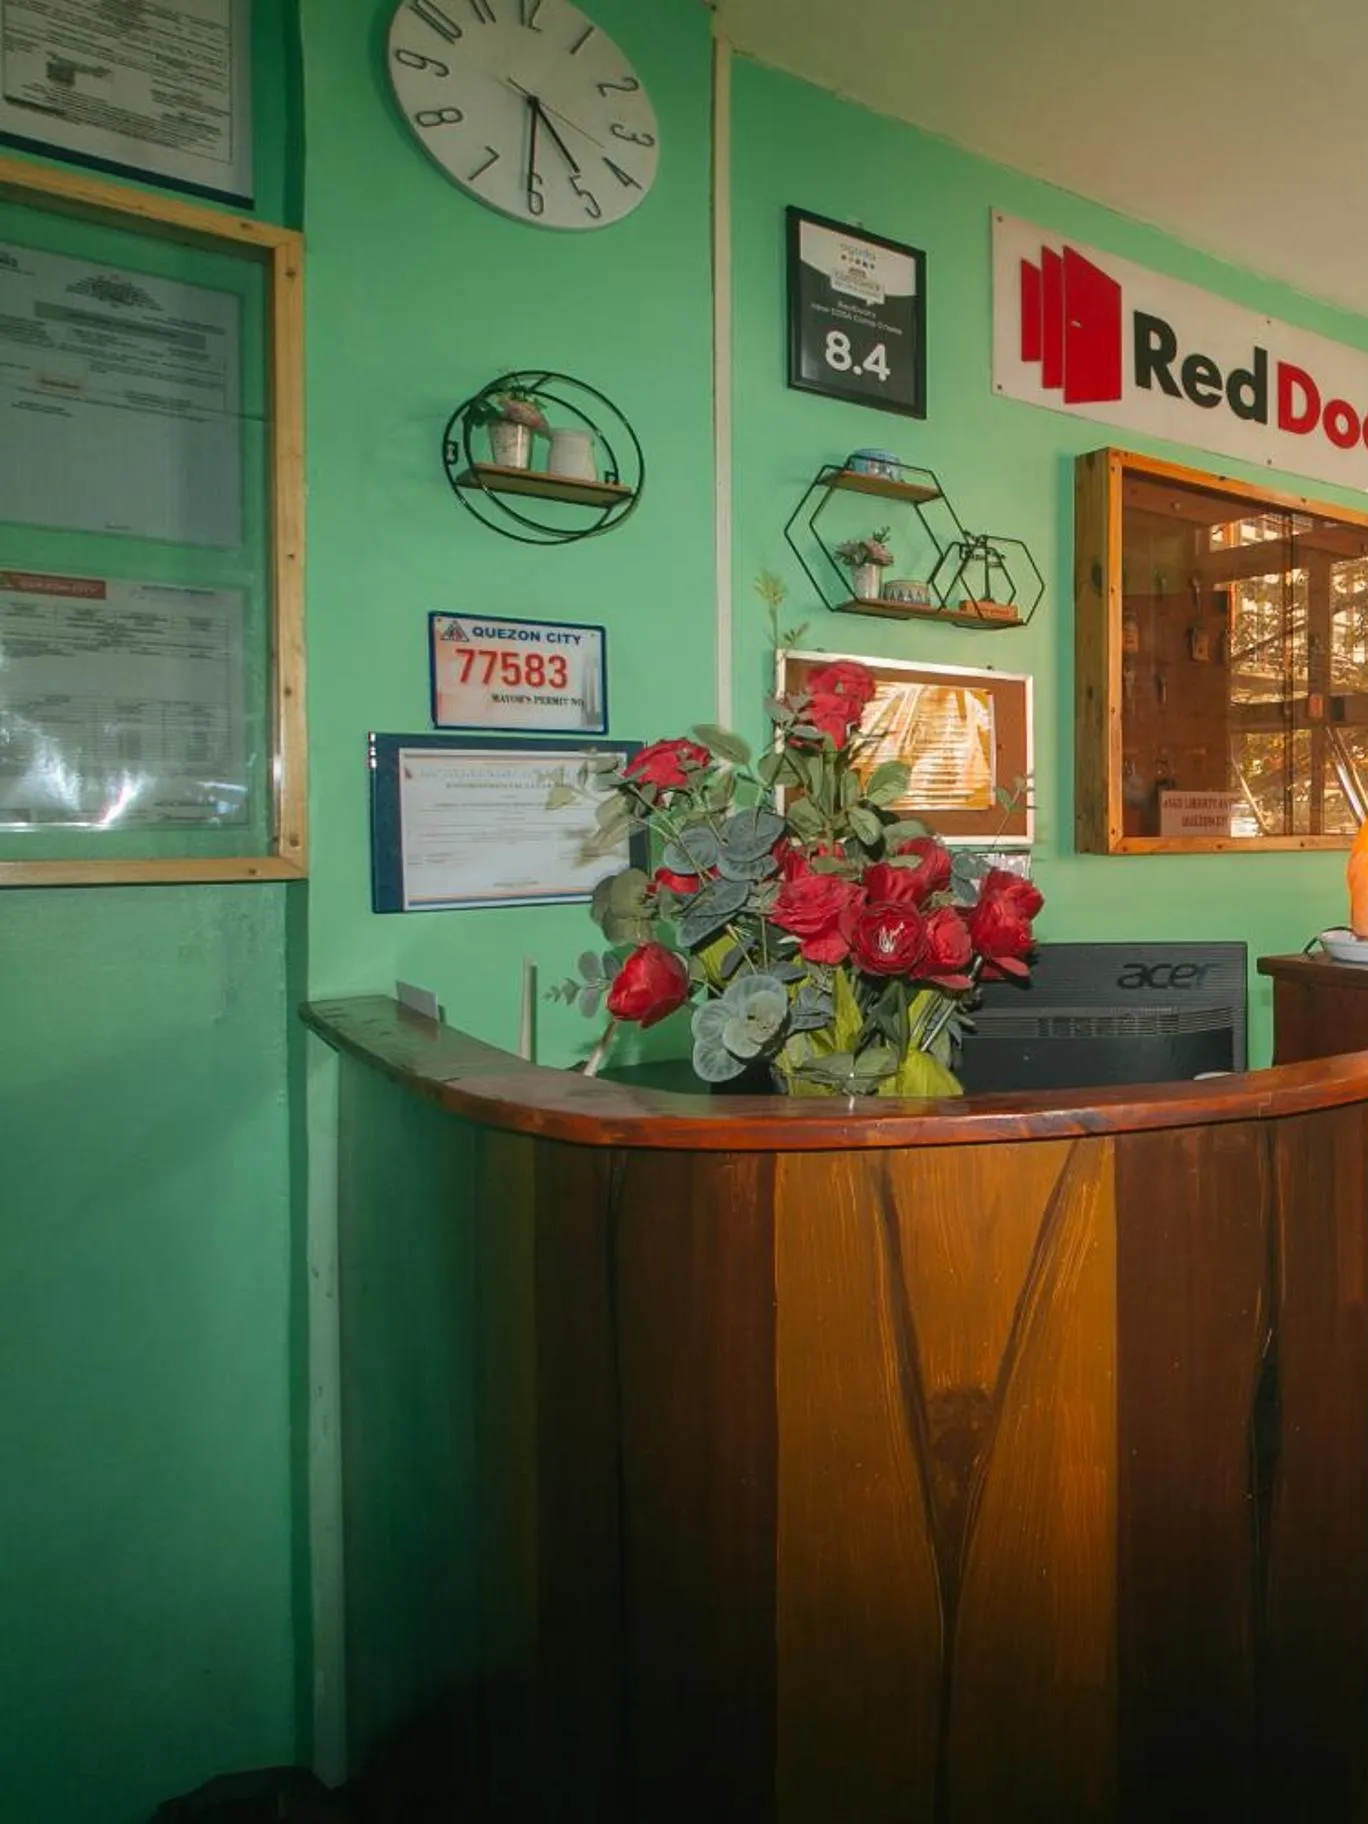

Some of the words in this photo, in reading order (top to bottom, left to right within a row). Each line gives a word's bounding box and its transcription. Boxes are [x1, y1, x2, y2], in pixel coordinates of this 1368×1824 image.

[569, 24, 596, 55] 1
[395, 48, 450, 78] 9
[596, 76, 640, 98] 2
[415, 106, 463, 128] 8
[609, 122, 655, 148] 3
[467, 145, 500, 181] 7
[602, 155, 643, 190] 4
[528, 171, 545, 216] 6
[568, 174, 602, 219] 5
[825, 330, 891, 382] 8.4
[471, 626, 541, 643] QUEZON
[546, 632, 583, 645] CITY
[455, 648, 568, 689] 77583
[1116, 962, 1224, 990] acer
